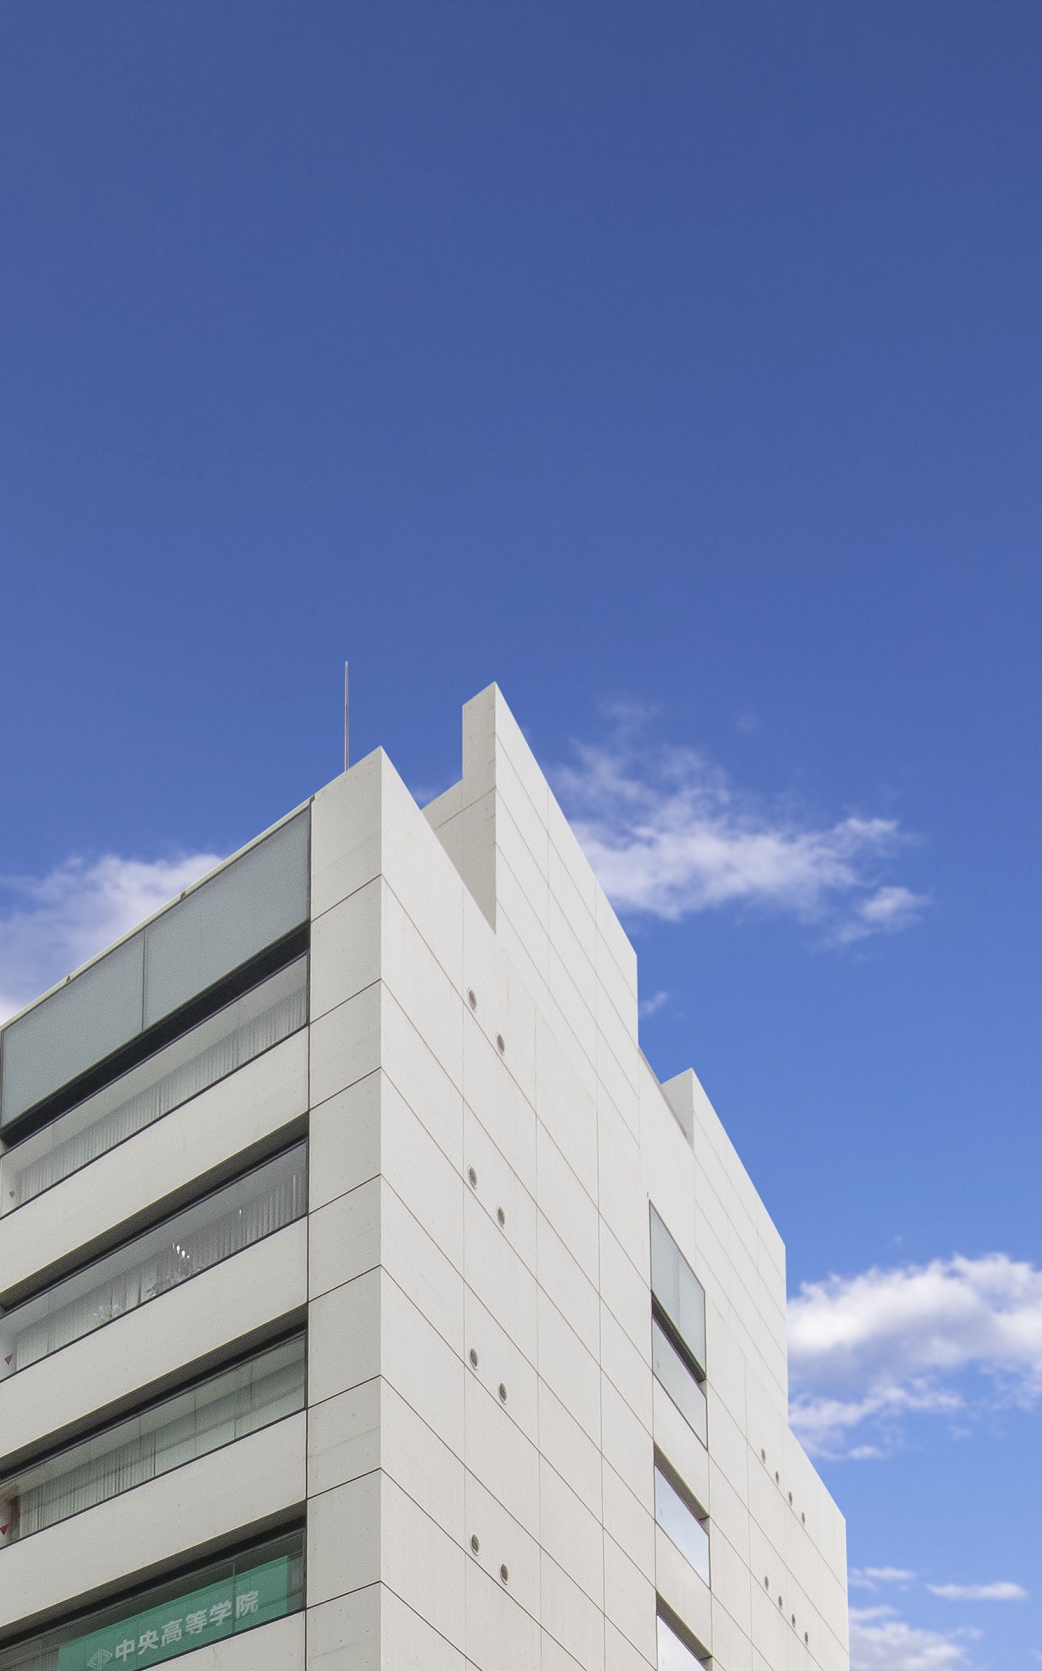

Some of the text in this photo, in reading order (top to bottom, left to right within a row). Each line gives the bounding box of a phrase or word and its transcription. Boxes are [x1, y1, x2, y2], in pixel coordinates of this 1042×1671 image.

[115, 1590, 259, 1662] 中央高等学院
